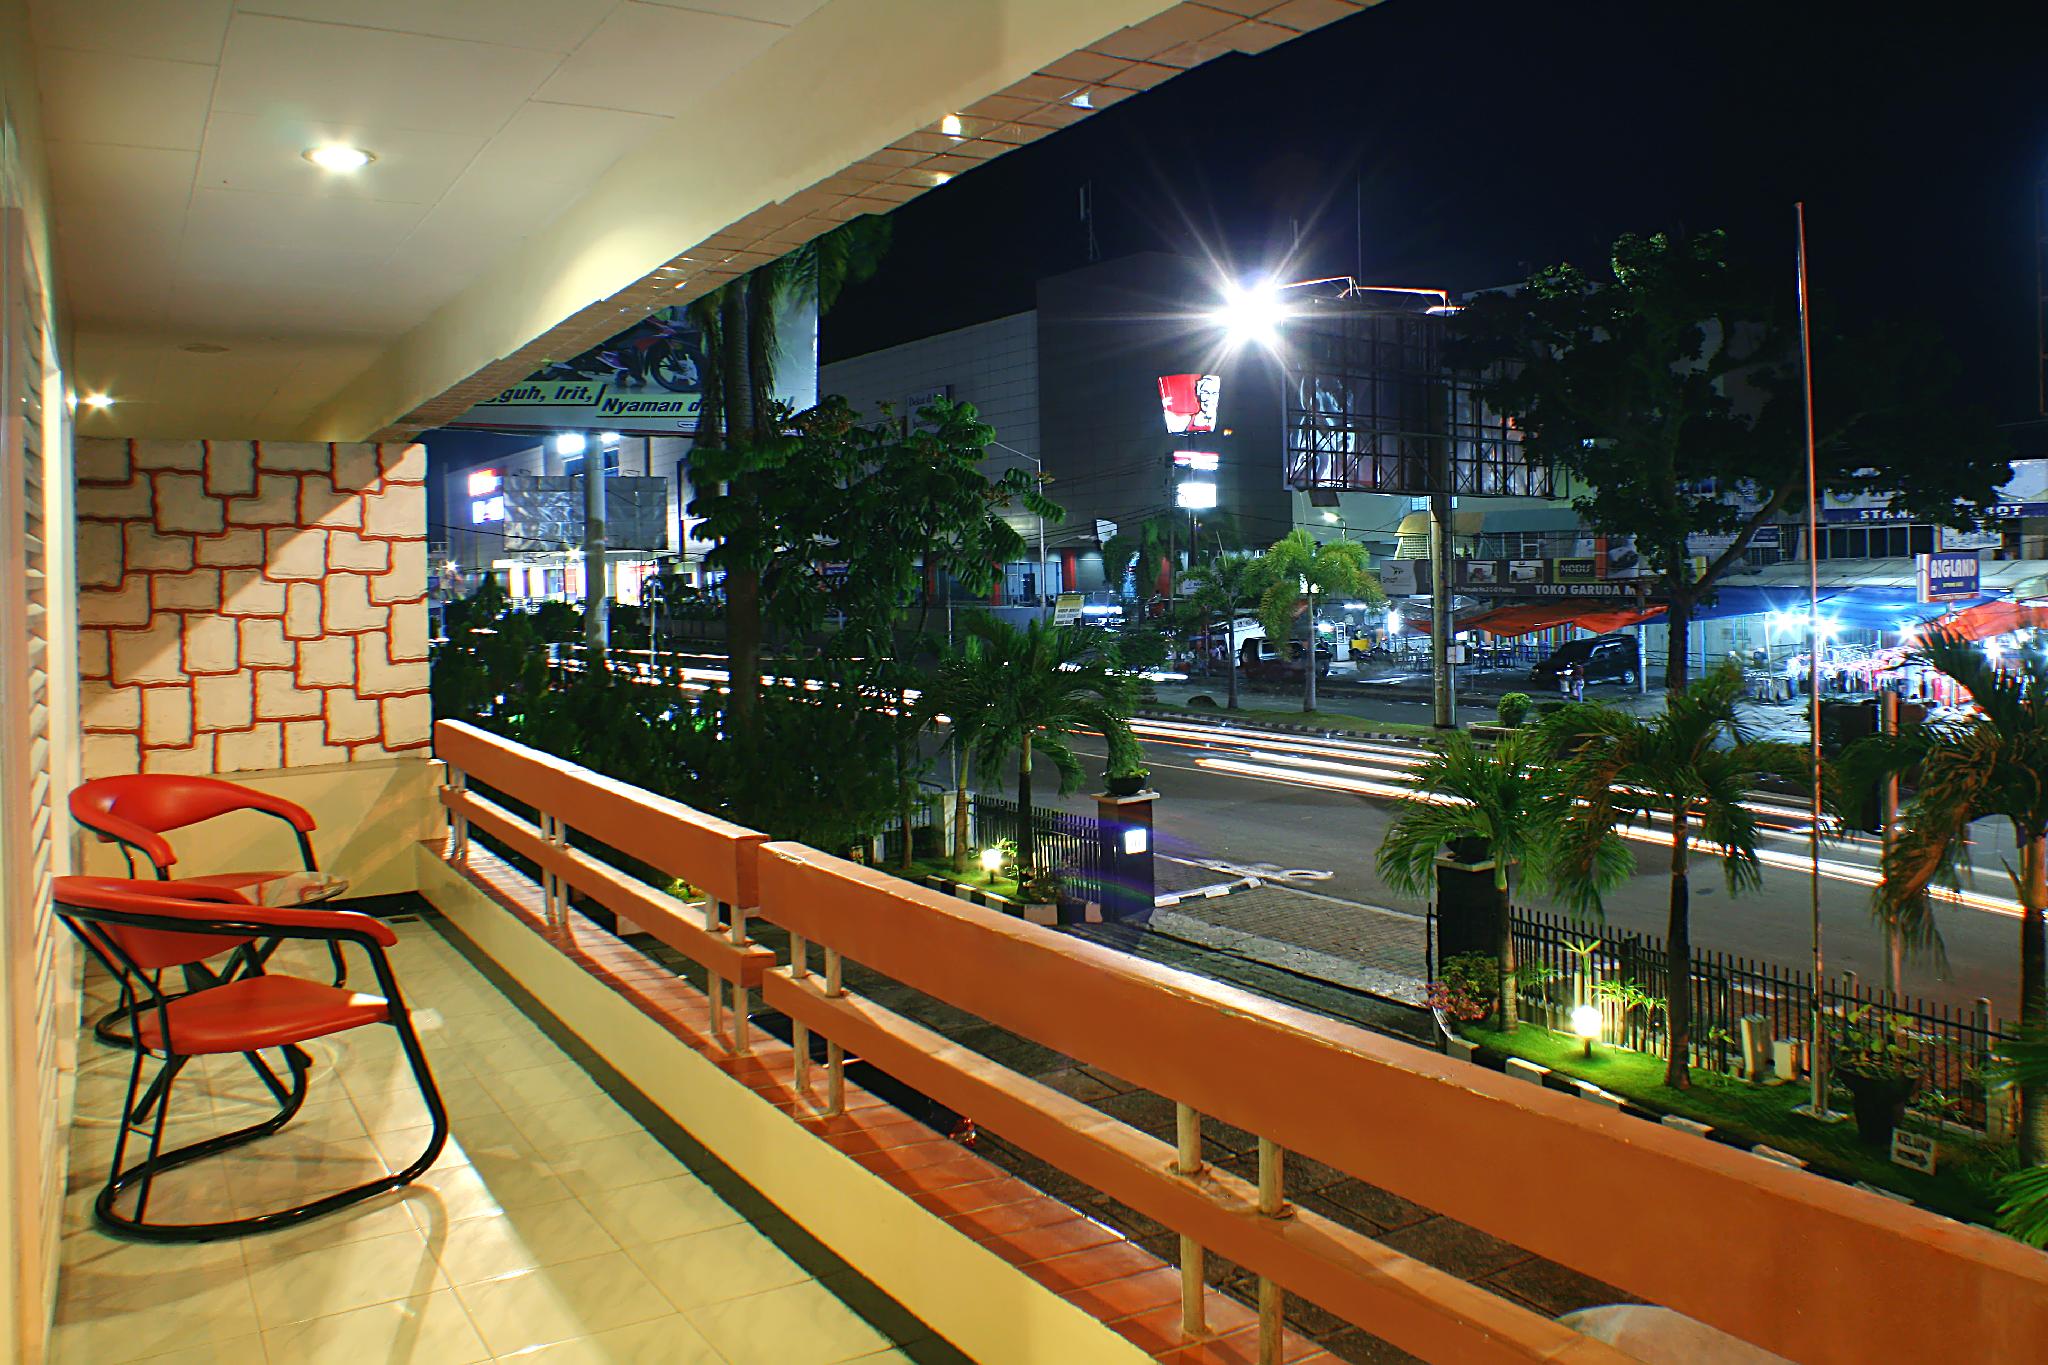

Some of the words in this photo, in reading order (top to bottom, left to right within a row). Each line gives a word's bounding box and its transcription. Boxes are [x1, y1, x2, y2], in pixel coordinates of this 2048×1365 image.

[486, 386, 547, 403] guh,
[554, 385, 594, 402] Irit,
[601, 398, 683, 415] Nyaman
[1930, 558, 1977, 579] BIGLAND
[1535, 584, 1566, 595] TOKO
[1570, 584, 1621, 595] GARUDA
